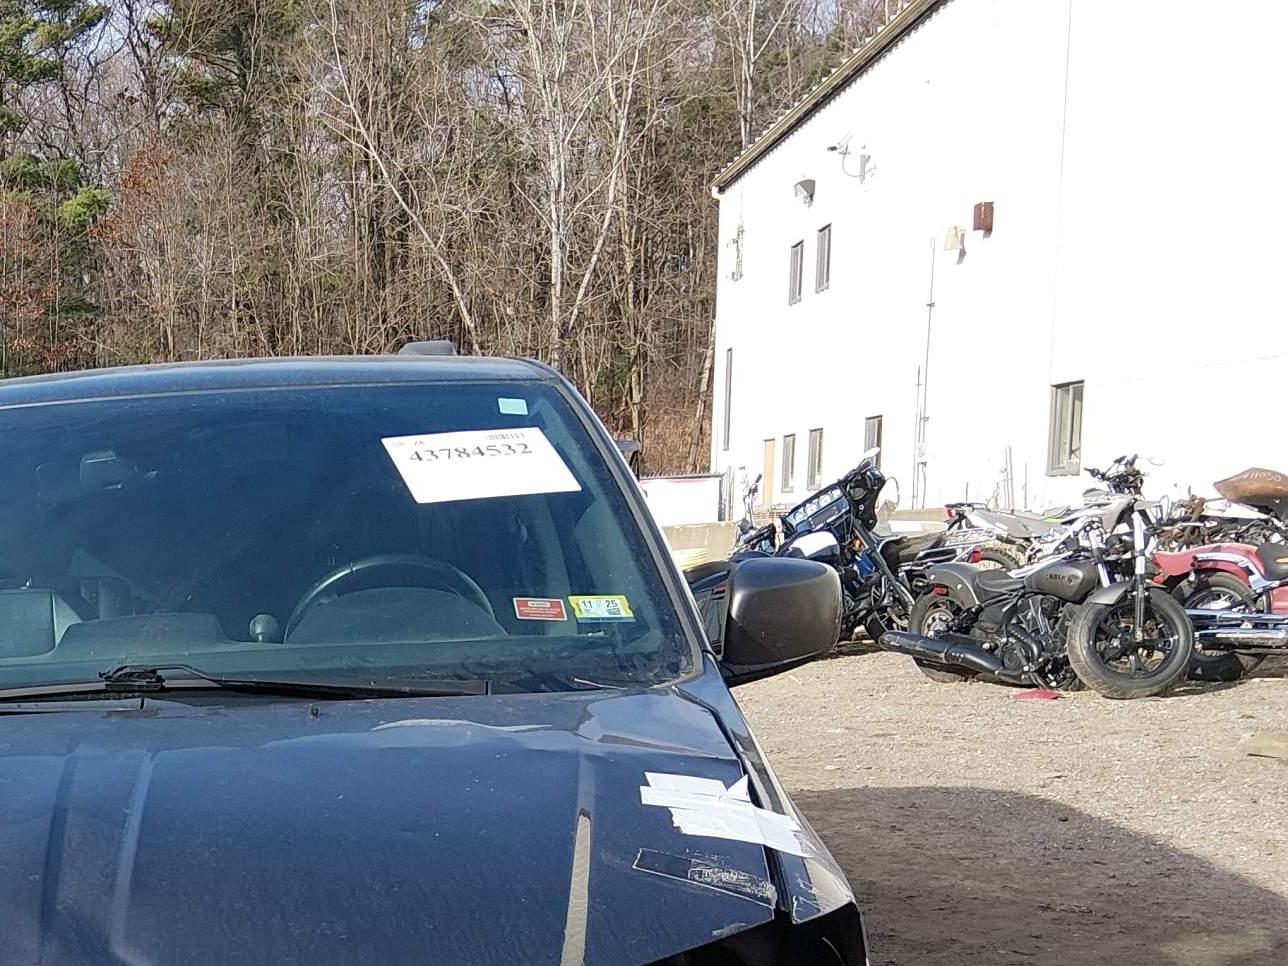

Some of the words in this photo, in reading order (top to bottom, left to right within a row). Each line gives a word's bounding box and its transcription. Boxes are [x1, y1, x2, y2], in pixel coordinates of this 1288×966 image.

[410, 443, 533, 461] 43784532
[582, 600, 593, 609] 11
[605, 599, 618, 608] 25
